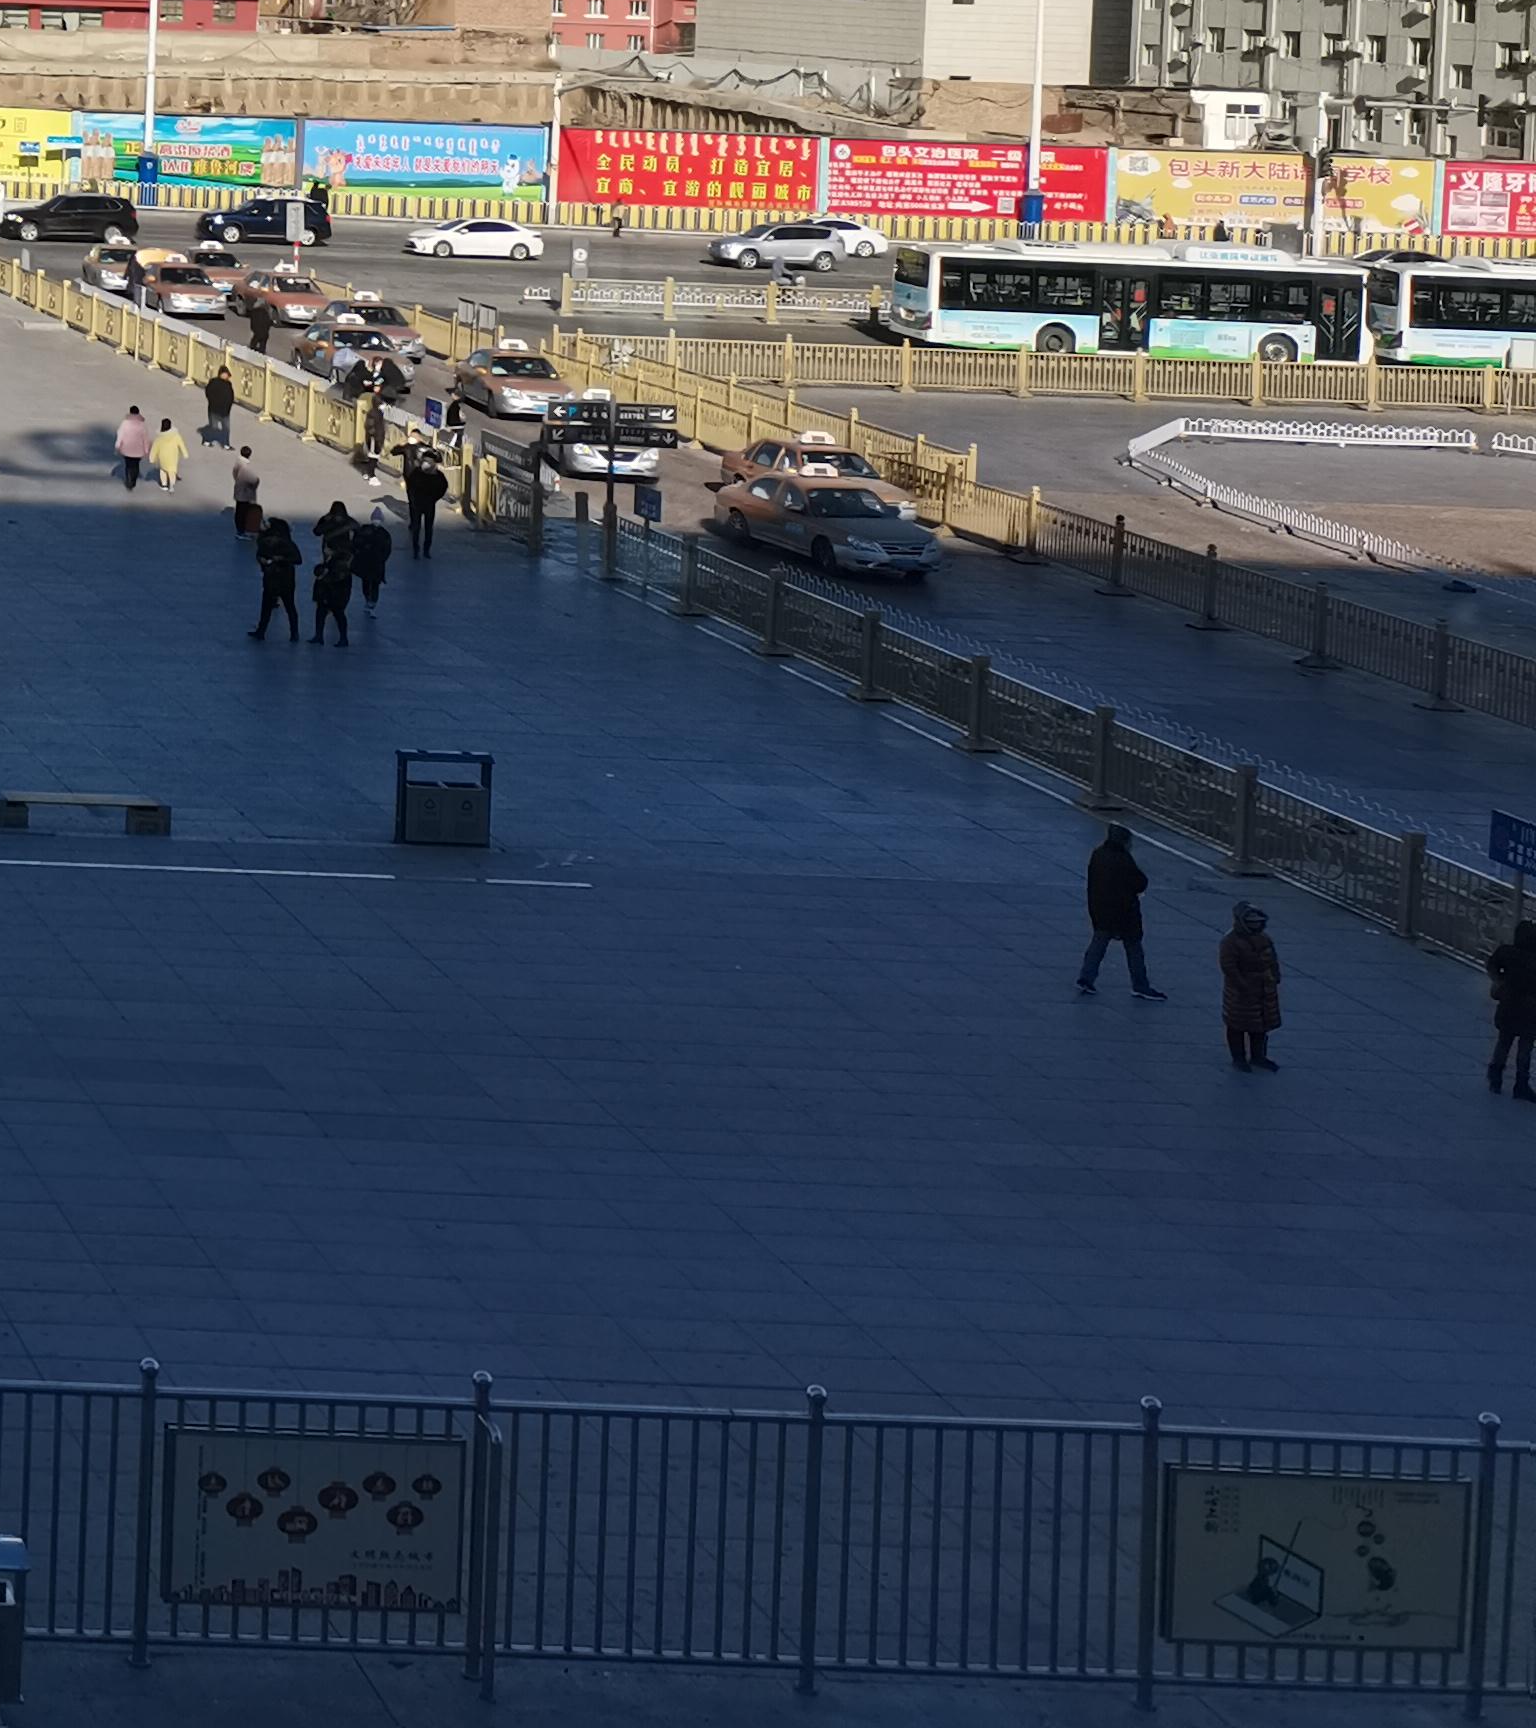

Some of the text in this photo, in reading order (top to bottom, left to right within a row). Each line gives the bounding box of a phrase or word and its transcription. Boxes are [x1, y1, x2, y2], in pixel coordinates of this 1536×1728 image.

[1168, 158, 1392, 185] 包头新大陆语学校
[568, 405, 577, 417] P
